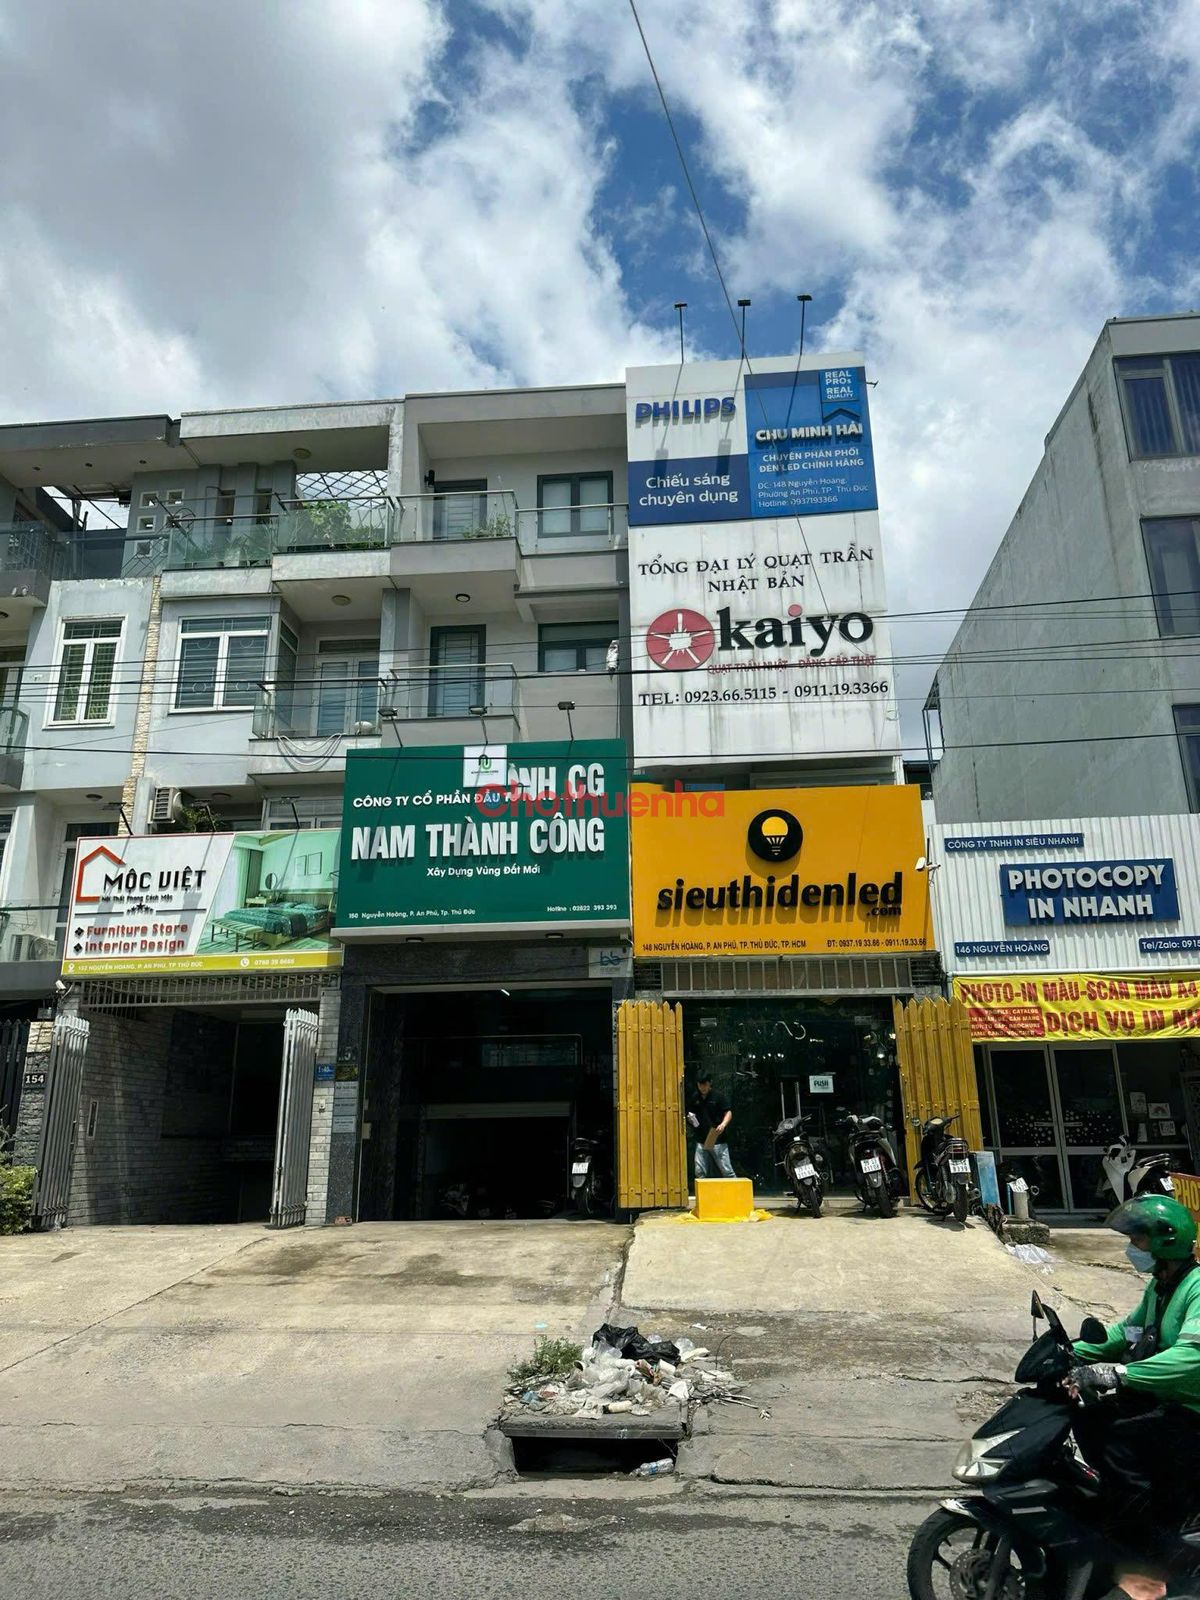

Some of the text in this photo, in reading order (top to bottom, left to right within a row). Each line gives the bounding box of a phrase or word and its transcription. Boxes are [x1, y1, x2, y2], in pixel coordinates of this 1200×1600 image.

[825, 370, 852, 379] REAL
[826, 386, 853, 395] REAL
[635, 396, 736, 420] PHILIPS
[791, 425, 832, 439] MINH
[782, 463, 800, 472] LED
[645, 473, 731, 489] Chiếu sáng
[639, 489, 739, 506] chuyên dụng
[790, 488, 801, 496] An
[638, 542, 874, 576] TỔNG ĐẠI LÝ QUẠT TRẦN
[708, 570, 805, 594] NHẬT BẢN
[717, 604, 874, 657] kaiyo
[639, 693, 680, 706] TEL:
[684, 687, 777, 703] 0923.66.5115
[794, 681, 889, 698] 0911.19.3366
[353, 795, 392, 808] CÔNG
[395, 796, 408, 806] TY
[412, 790, 433, 806] CỔ
[436, 790, 470, 804] PHẦN
[351, 812, 605, 860] NAM THÀNH CÔNG
[947, 837, 1080, 849] CÔNG TY TNHH IN SIÊU NHANH
[427, 863, 541, 877] Xây Dựng Vùng Đất Mới
[1008, 864, 1164, 891] PHOTOCOPY
[103, 868, 152, 893] MỘC
[657, 872, 902, 911] sieuthidenled
[867, 906, 901, 916] .com
[1028, 894, 1154, 919] IN NHANH
[87, 923, 188, 936] Furniture Store
[85, 940, 184, 953] Interior Design
[956, 945, 970, 953] 146
[972, 942, 1012, 953] NGUYỄN
[1142, 941, 1180, 950] Tel/Zalo:
[1042, 978, 1130, 1002] MÀU-SCAN
[1045, 1012, 1099, 1037] DỊCH
[1104, 1010, 1136, 1036] VỤ
[1142, 1010, 1165, 1031] IN
[25, 1074, 45, 1084] 154
[1173, 1177, 1200, 1211] PHO
